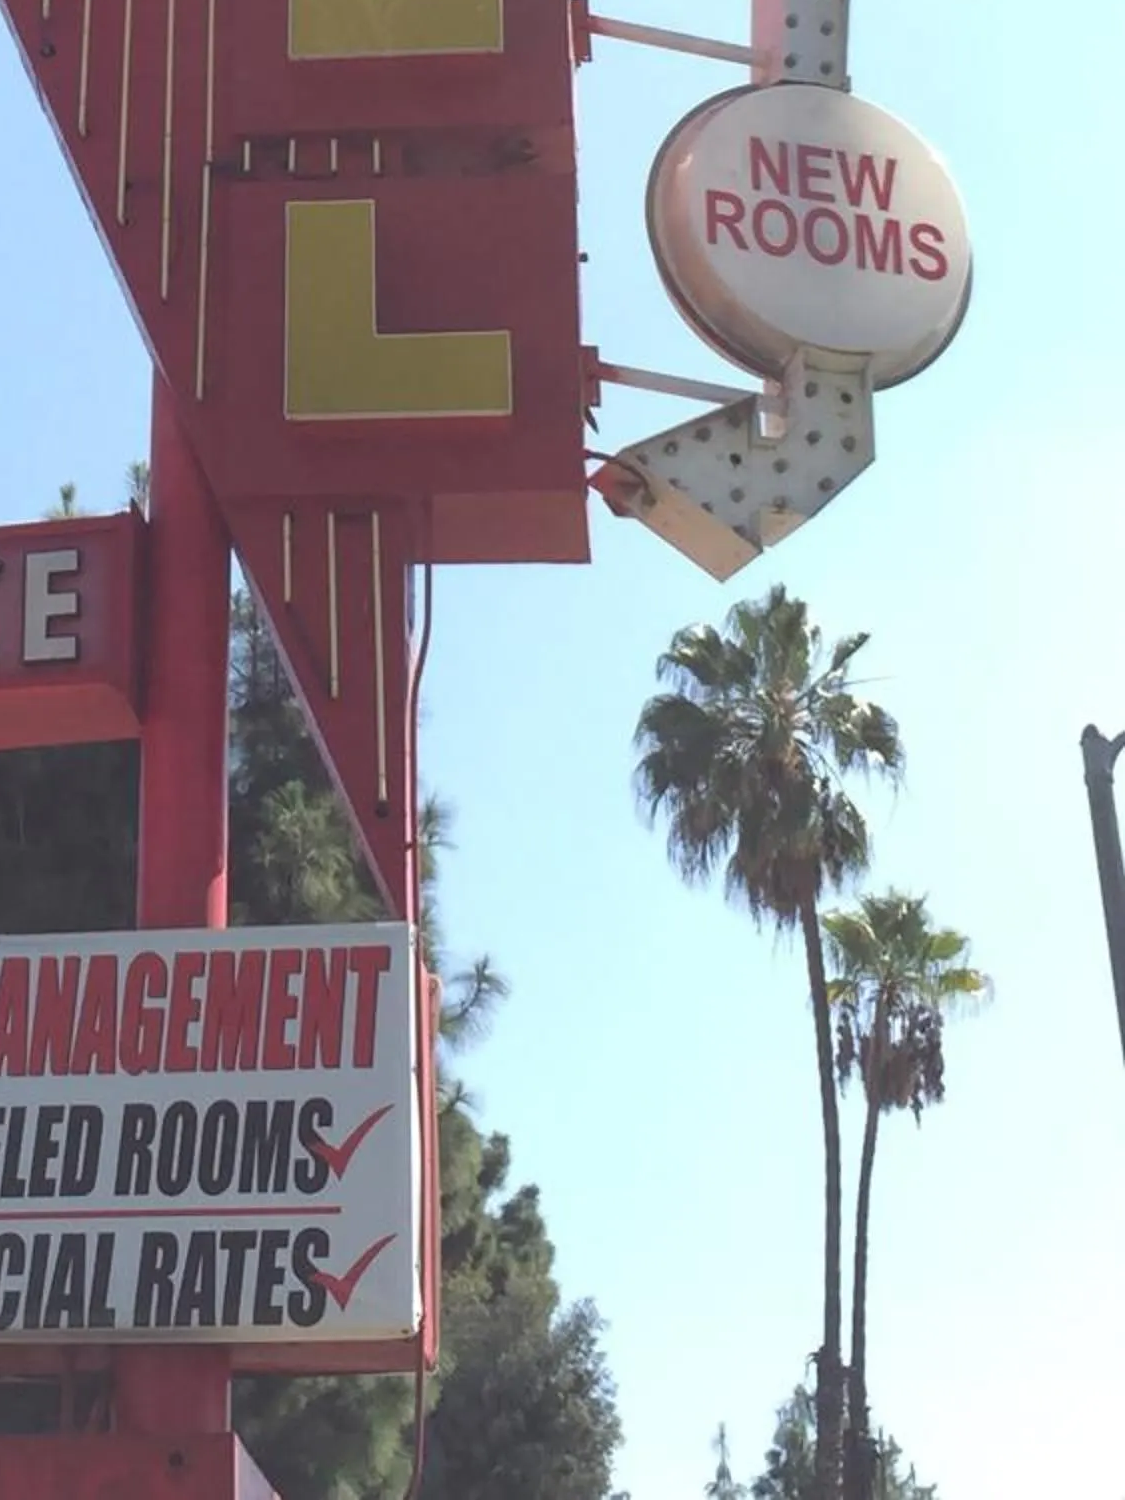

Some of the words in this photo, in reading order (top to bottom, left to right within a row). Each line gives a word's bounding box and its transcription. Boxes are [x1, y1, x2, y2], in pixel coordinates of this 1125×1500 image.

[748, 136, 898, 211] NEW
[704, 190, 949, 282] ROOMS
[115, 1097, 335, 1197] ROOMS
[132, 1228, 333, 1329] RATES
